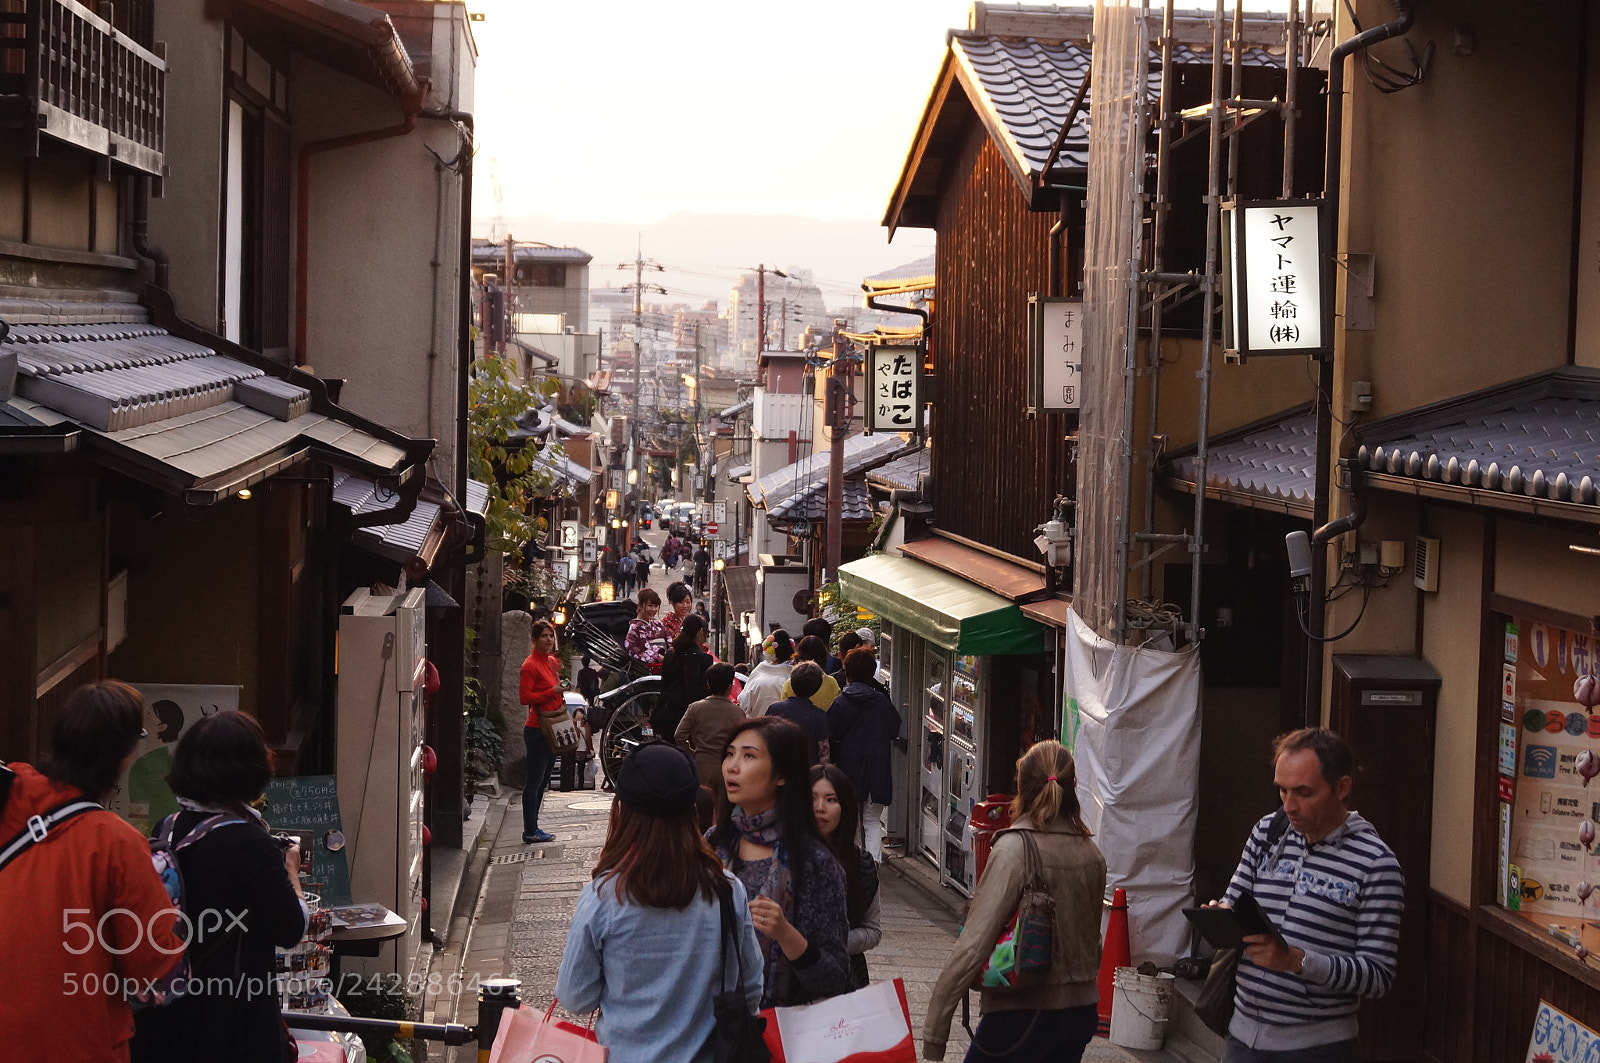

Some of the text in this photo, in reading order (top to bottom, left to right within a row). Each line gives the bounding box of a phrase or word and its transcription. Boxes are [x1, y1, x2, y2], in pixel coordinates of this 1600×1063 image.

[877, 363, 891, 416] やさか
[891, 354, 913, 425] たばこ
